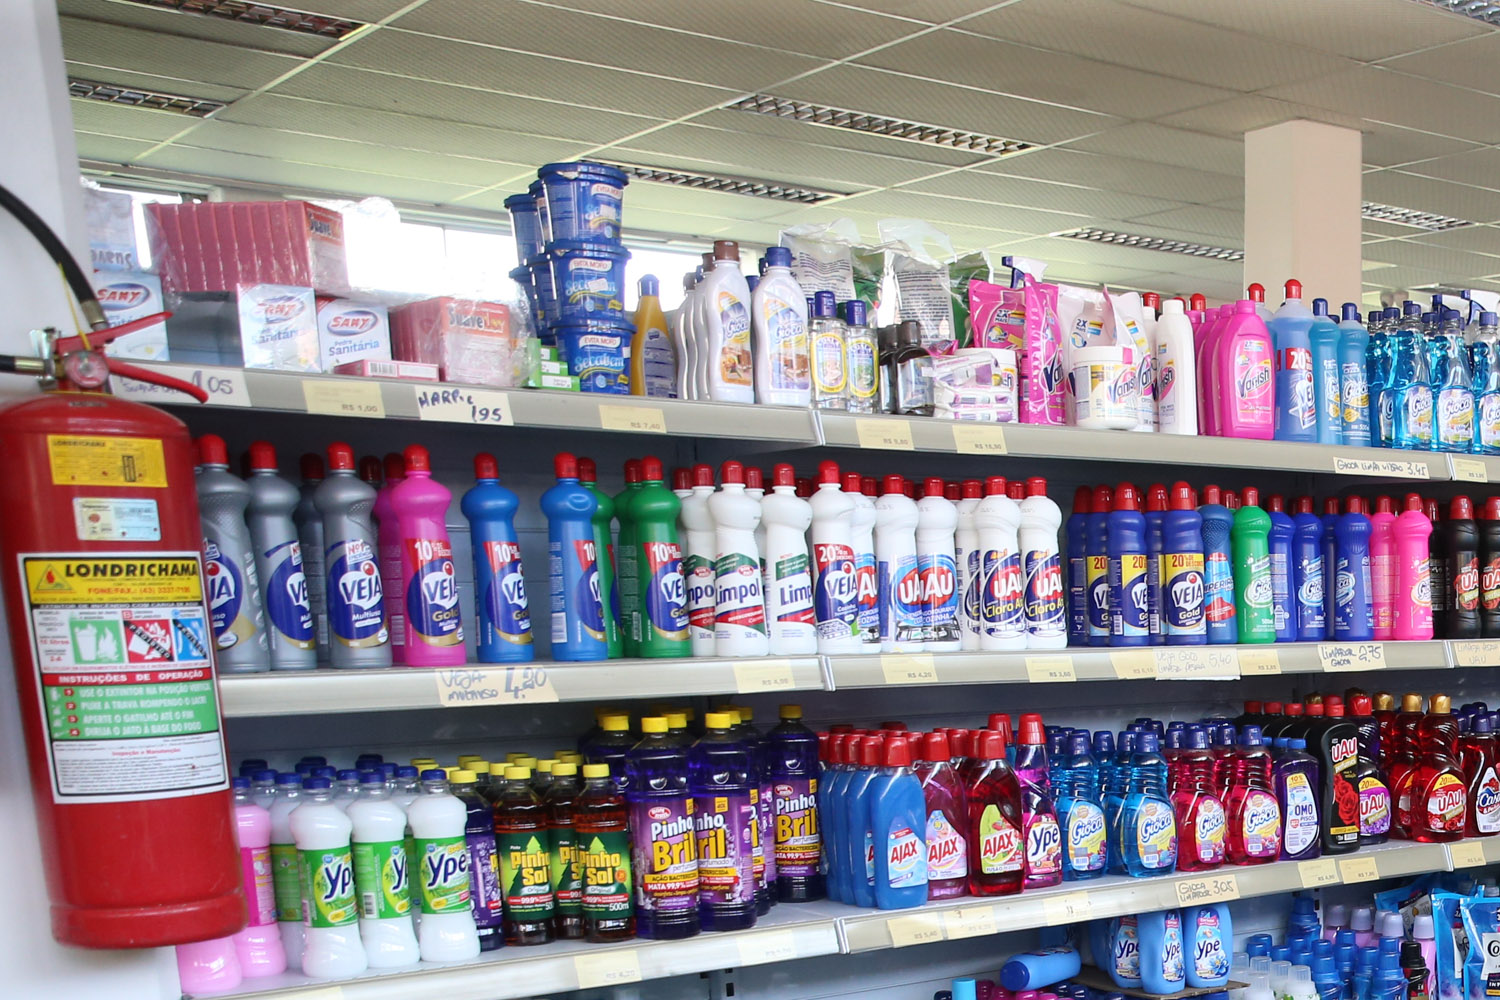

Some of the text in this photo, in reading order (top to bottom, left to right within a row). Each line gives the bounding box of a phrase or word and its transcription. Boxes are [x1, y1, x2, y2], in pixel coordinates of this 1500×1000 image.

[97, 288, 141, 302] SANY
[331, 315, 370, 330] SANY
[1076, 319, 1088, 328] 2X
[328, 338, 380, 357] Sanitária
[1239, 366, 1271, 399] Vanish
[495, 544, 510, 562] 10
[652, 544, 668, 561] 10
[65, 562, 198, 577] LONDRICHAMA
[342, 575, 382, 602] VEJA
[716, 577, 761, 604] Limpol
[828, 574, 857, 599] VEJA
[1174, 583, 1203, 608] VEJA
[352, 610, 381, 621] Multiuso
[986, 603, 1013, 618] Cloro
[1028, 603, 1055, 617] Cloro
[1179, 610, 1201, 619] Gold
[129, 623, 170, 658] PROIBIDO
[59, 674, 127, 684] INSTRUÇÕES
[158, 670, 204, 681] OPERAÇÃO
[79, 684, 189, 697] USE EXTINTOR POSIÇÃO
[112, 700, 138, 709] TRAVA
[83, 710, 174, 724] APERTE GATILHO ATÉ
[151, 724, 170, 733] BASE
[1331, 737, 1357, 762] UAU
[777, 794, 817, 815] Pinho
[1360, 798, 1385, 816] UAU
[1438, 789, 1462, 812] UAU
[1479, 793, 1500, 808] Casa
[1295, 804, 1313, 816] OMO
[652, 814, 694, 841] Pinho
[777, 808, 818, 842] Bril
[653, 830, 695, 872] Bril
[890, 840, 917, 864] AJAX
[928, 836, 958, 863] AJAX
[983, 829, 1015, 858] AJAX
[522, 866, 548, 886] Sol
[587, 867, 613, 885] Sol
[652, 874, 668, 882] AÇÃO
